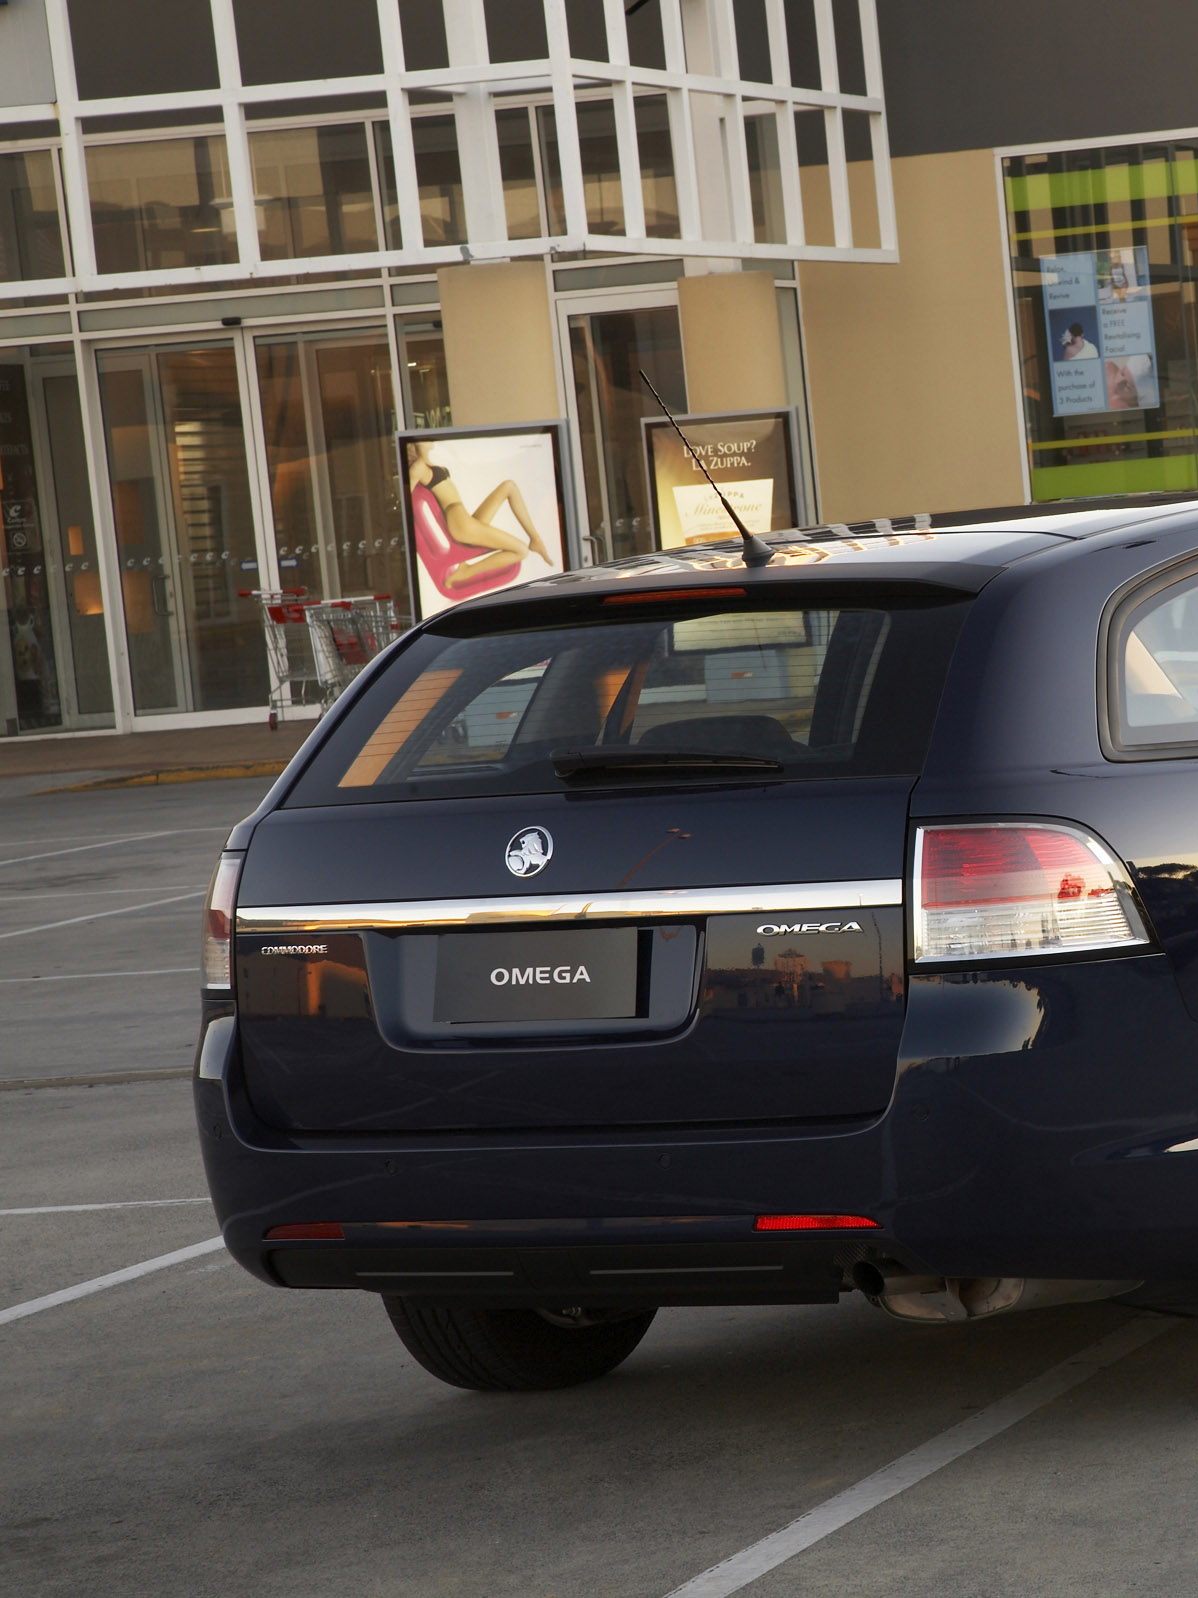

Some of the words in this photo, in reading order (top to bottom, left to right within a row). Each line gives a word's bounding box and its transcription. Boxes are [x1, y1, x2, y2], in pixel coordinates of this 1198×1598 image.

[1074, 277, 1080, 285] &
[1102, 307, 1127, 316] Receive
[1056, 370, 1073, 378] With
[1074, 368, 1084, 377] the
[1058, 382, 1088, 392] purchase
[1089, 381, 1096, 389] of
[1065, 395, 1093, 405] Products
[683, 444, 714, 458] LOVE
[717, 440, 757, 455] SOUP?
[709, 456, 752, 470] ZUPPA.
[755, 921, 865, 937] OMEGA
[261, 944, 329, 956] COMMODORE
[489, 964, 592, 987] OMEGA
